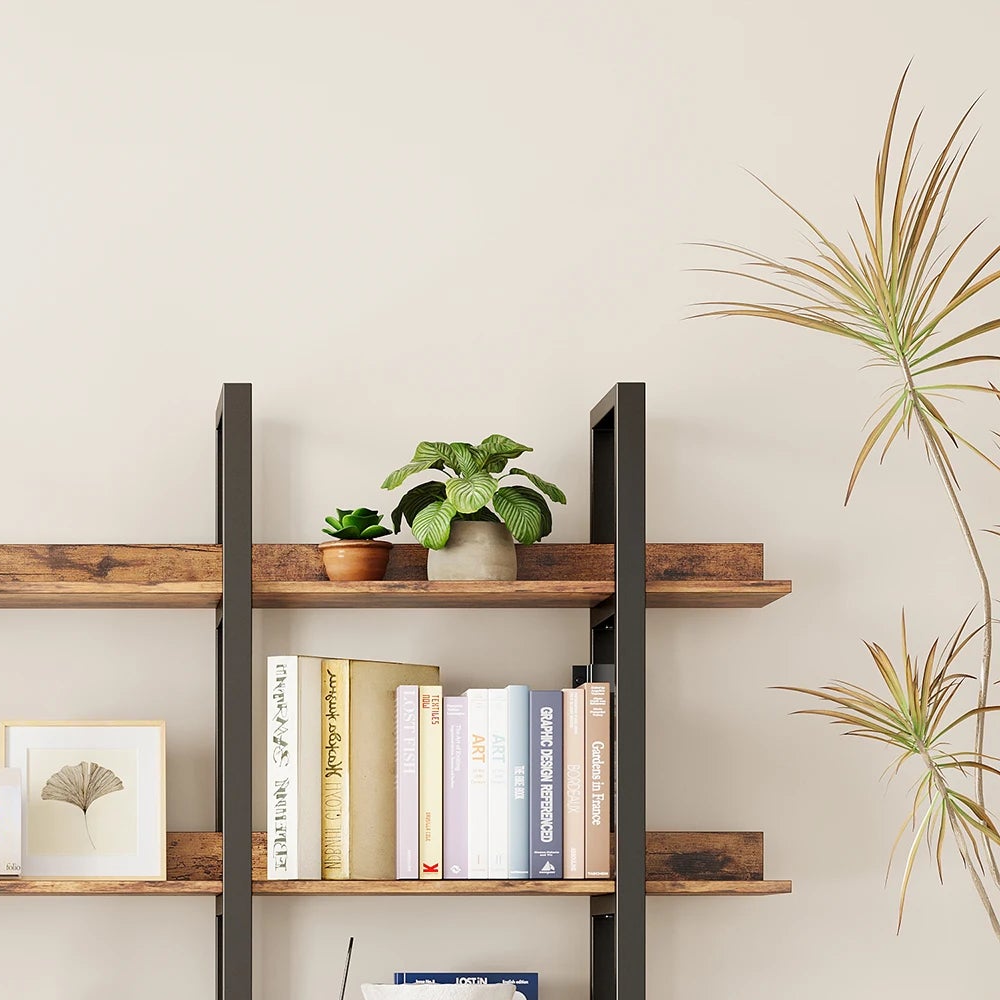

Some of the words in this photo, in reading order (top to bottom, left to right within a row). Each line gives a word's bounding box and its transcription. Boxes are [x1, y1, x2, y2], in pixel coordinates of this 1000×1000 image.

[403, 690, 416, 734] LOST
[422, 694, 430, 709] NOW
[431, 694, 440, 725] TEXTILES
[540, 706, 553, 747] GRAPHIC
[403, 738, 416, 775] FISH
[472, 734, 485, 763] ART
[492, 734, 506, 763] ART
[591, 741, 605, 780] Gardens
[540, 749, 553, 782] DESIGN
[591, 781, 605, 791] in
[540, 784, 553, 843] REFERENCED
[591, 793, 605, 826] France
[6, 862, 21, 871] folio
[423, 863, 439, 872] K
